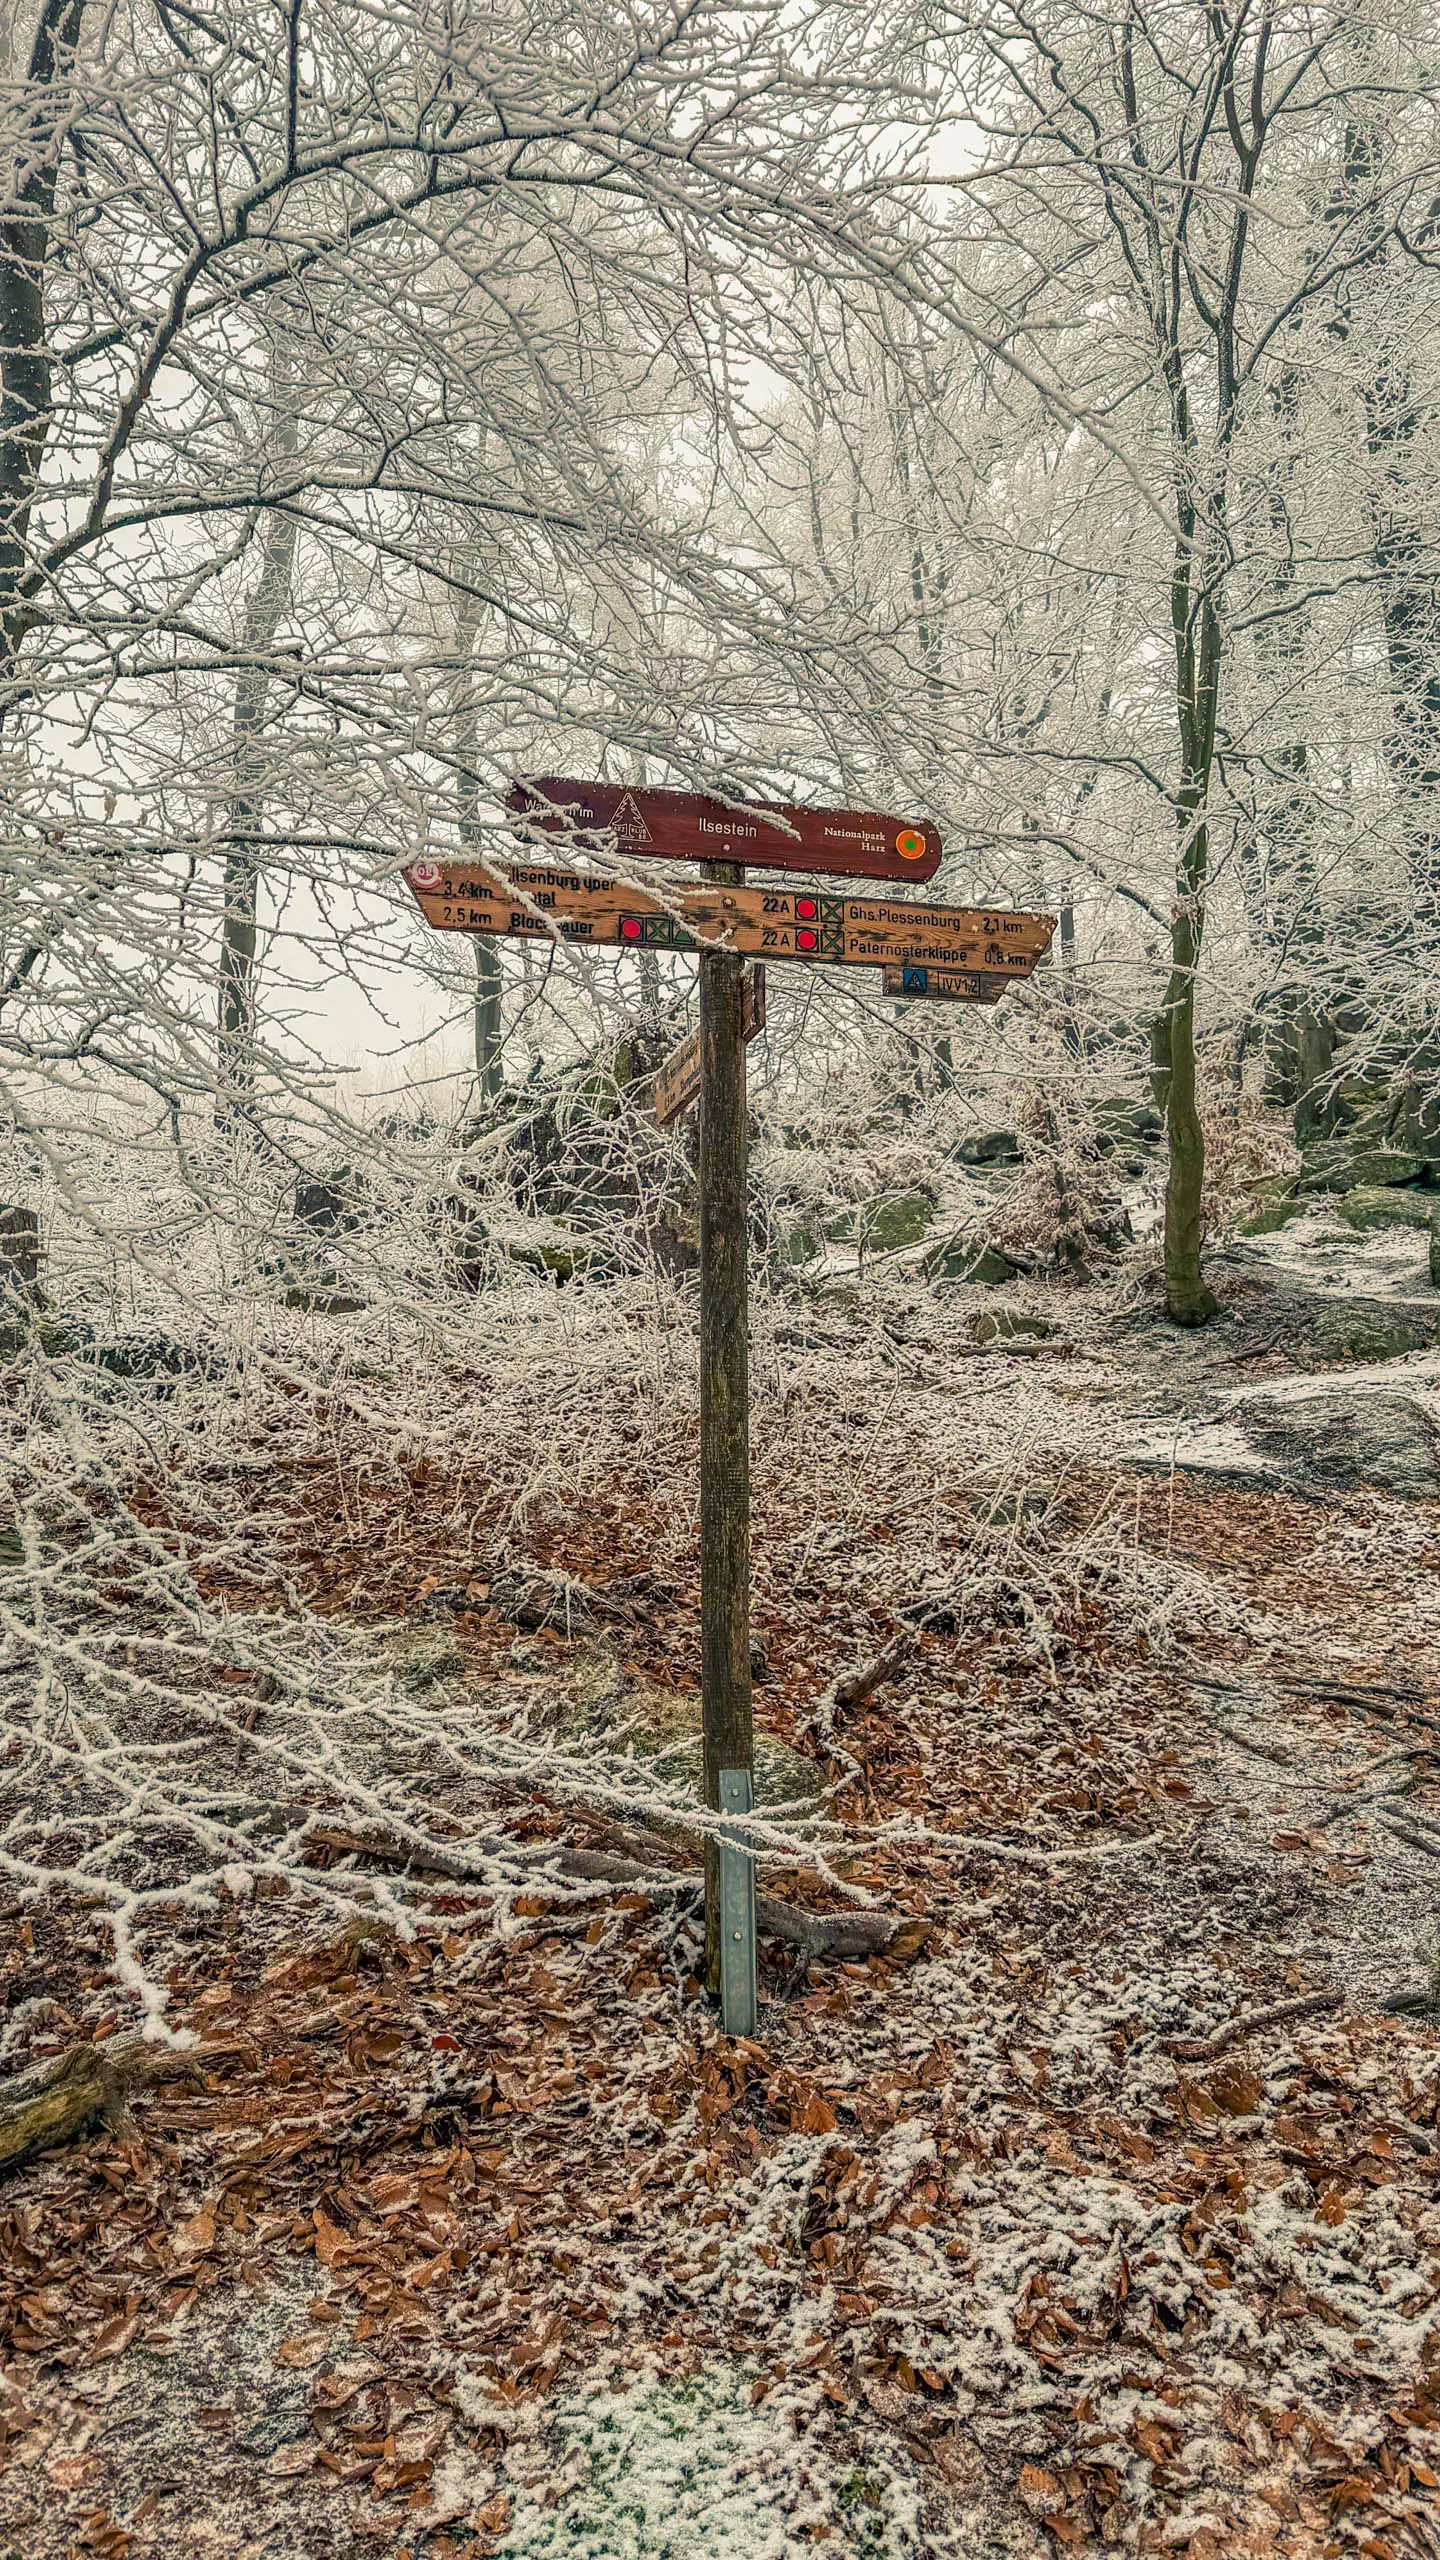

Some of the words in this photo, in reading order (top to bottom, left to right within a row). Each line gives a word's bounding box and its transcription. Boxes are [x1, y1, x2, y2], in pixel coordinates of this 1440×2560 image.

[580, 808, 594, 819] im
[699, 817, 757, 837] Ilsestein
[824, 827, 886, 841] Nationalpark
[861, 842, 886, 853] Harz
[511, 867, 580, 890] Ilsenburg
[470, 882, 493, 898] km
[470, 909, 492, 925] km
[510, 912, 595, 934] Blocauer
[1003, 919, 1023, 934] km
[850, 939, 967, 962] Paternosterklippe
[1008, 952, 1027, 967] km
